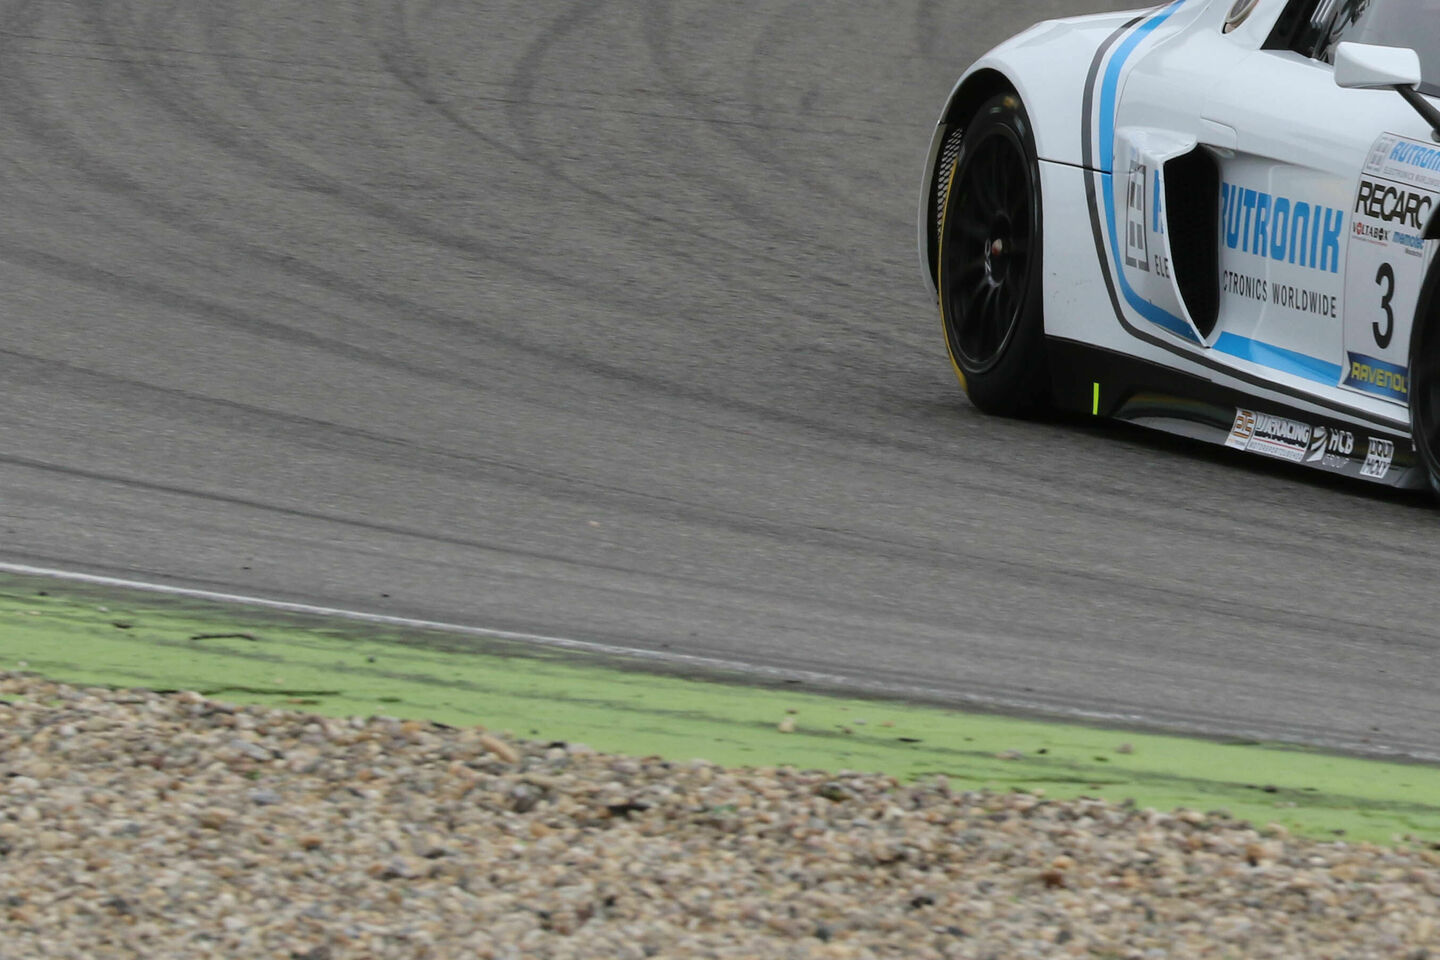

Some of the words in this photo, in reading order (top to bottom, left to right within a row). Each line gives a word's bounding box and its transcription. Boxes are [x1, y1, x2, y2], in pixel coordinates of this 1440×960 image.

[1272, 282, 1337, 319] WORLDWIDE
[1372, 262, 1395, 349] 3
[1351, 361, 1408, 394] RAVENOL
